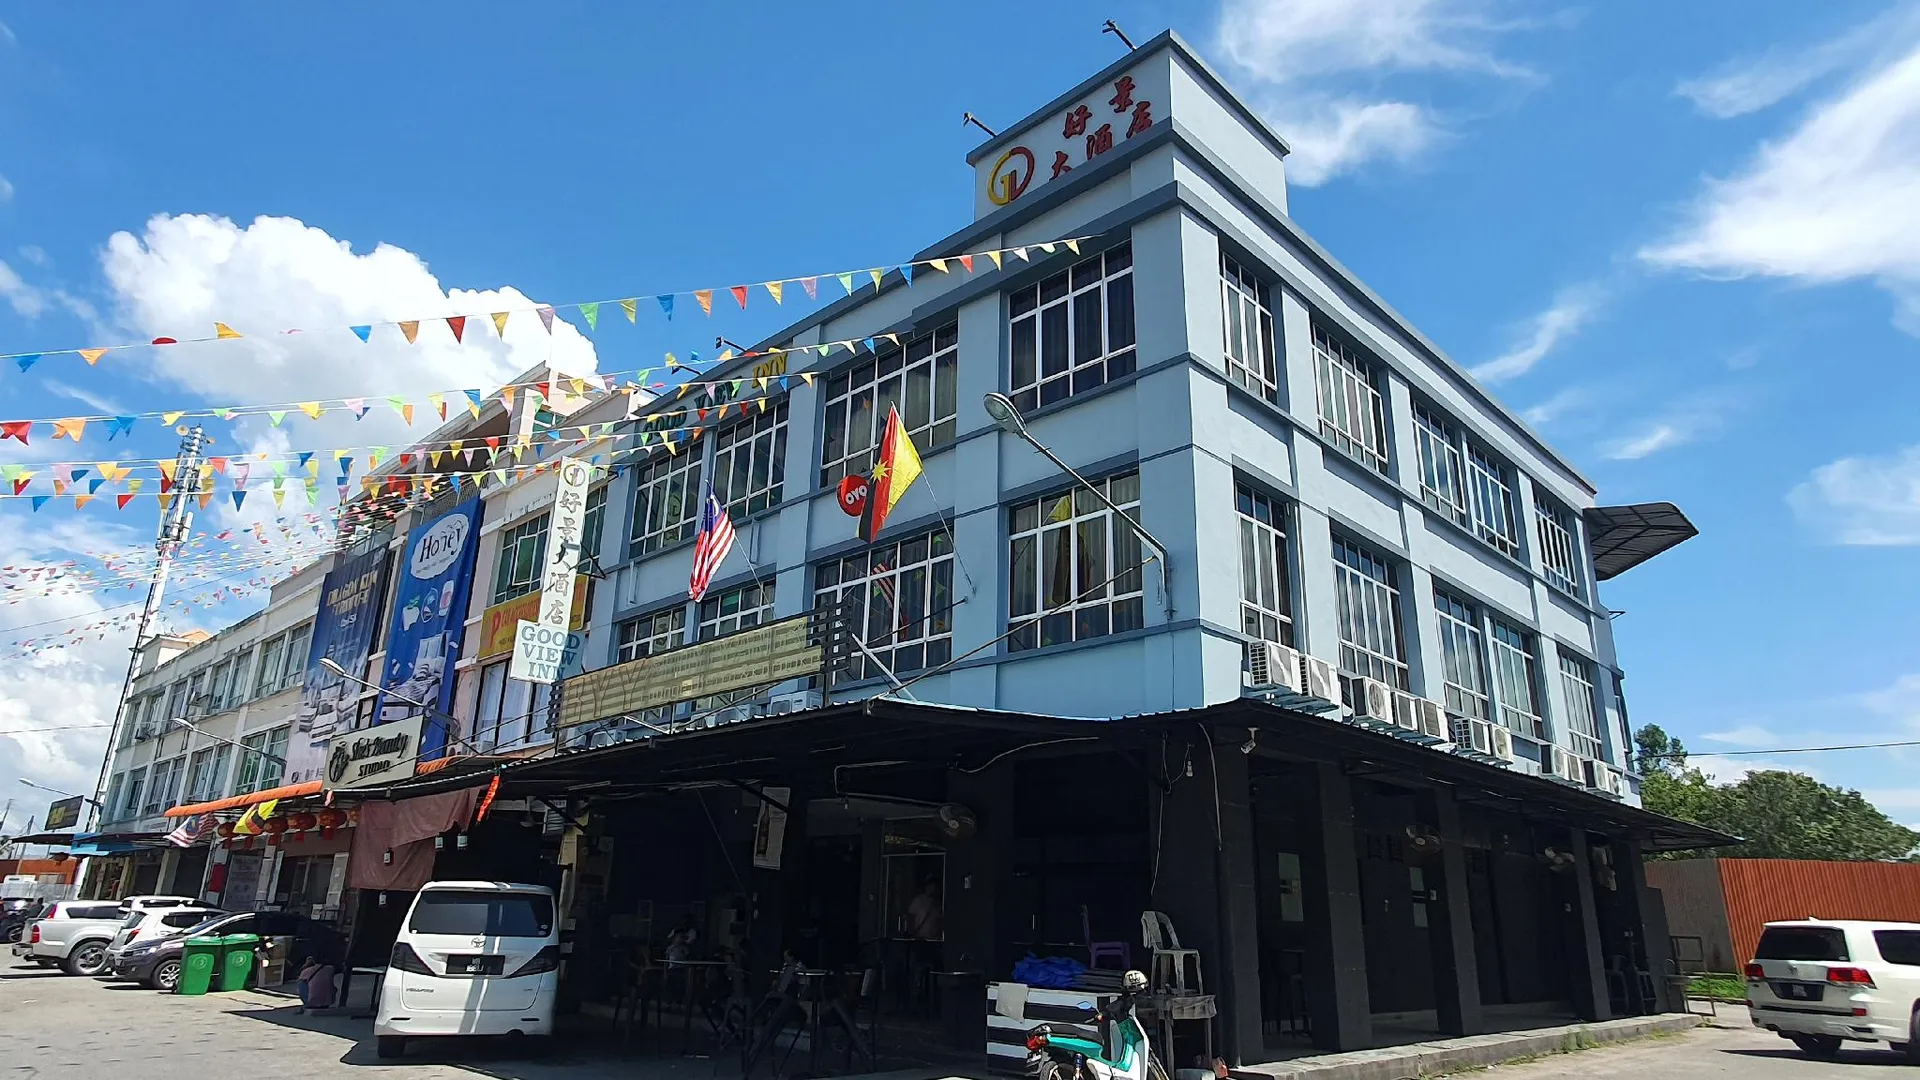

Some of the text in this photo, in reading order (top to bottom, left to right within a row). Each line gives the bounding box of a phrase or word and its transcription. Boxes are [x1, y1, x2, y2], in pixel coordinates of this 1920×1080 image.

[1049, 101, 1152, 181] 大酒店
[751, 353, 789, 388] INN
[845, 485, 868, 505] OYO
[521, 625, 581, 650] GOOD
[522, 642, 578, 666] VIEW
[527, 661, 566, 680] INN
